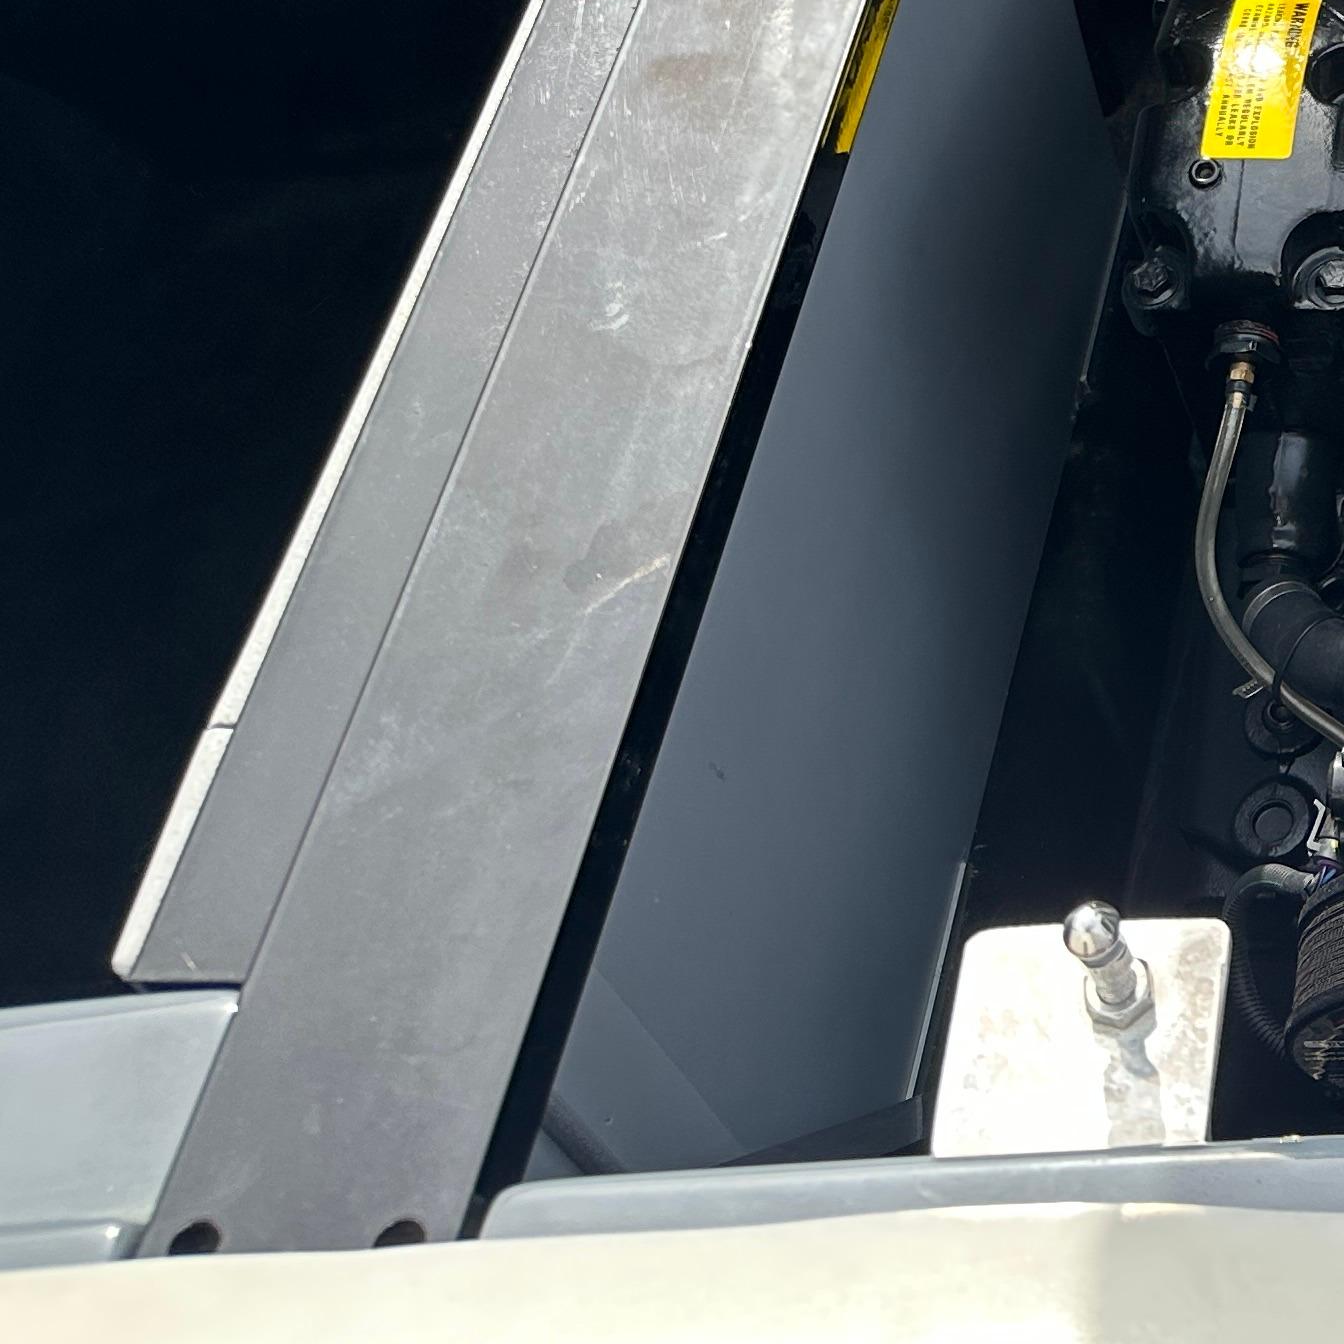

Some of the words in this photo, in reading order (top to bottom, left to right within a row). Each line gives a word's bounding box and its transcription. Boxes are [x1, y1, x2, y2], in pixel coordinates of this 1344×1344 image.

[1285, 2, 1310, 48] WARNING
[1215, 94, 1230, 136] ANNUALLY
[1227, 103, 1239, 131] LEAKS
[1246, 105, 1263, 148] EXPLOSION
